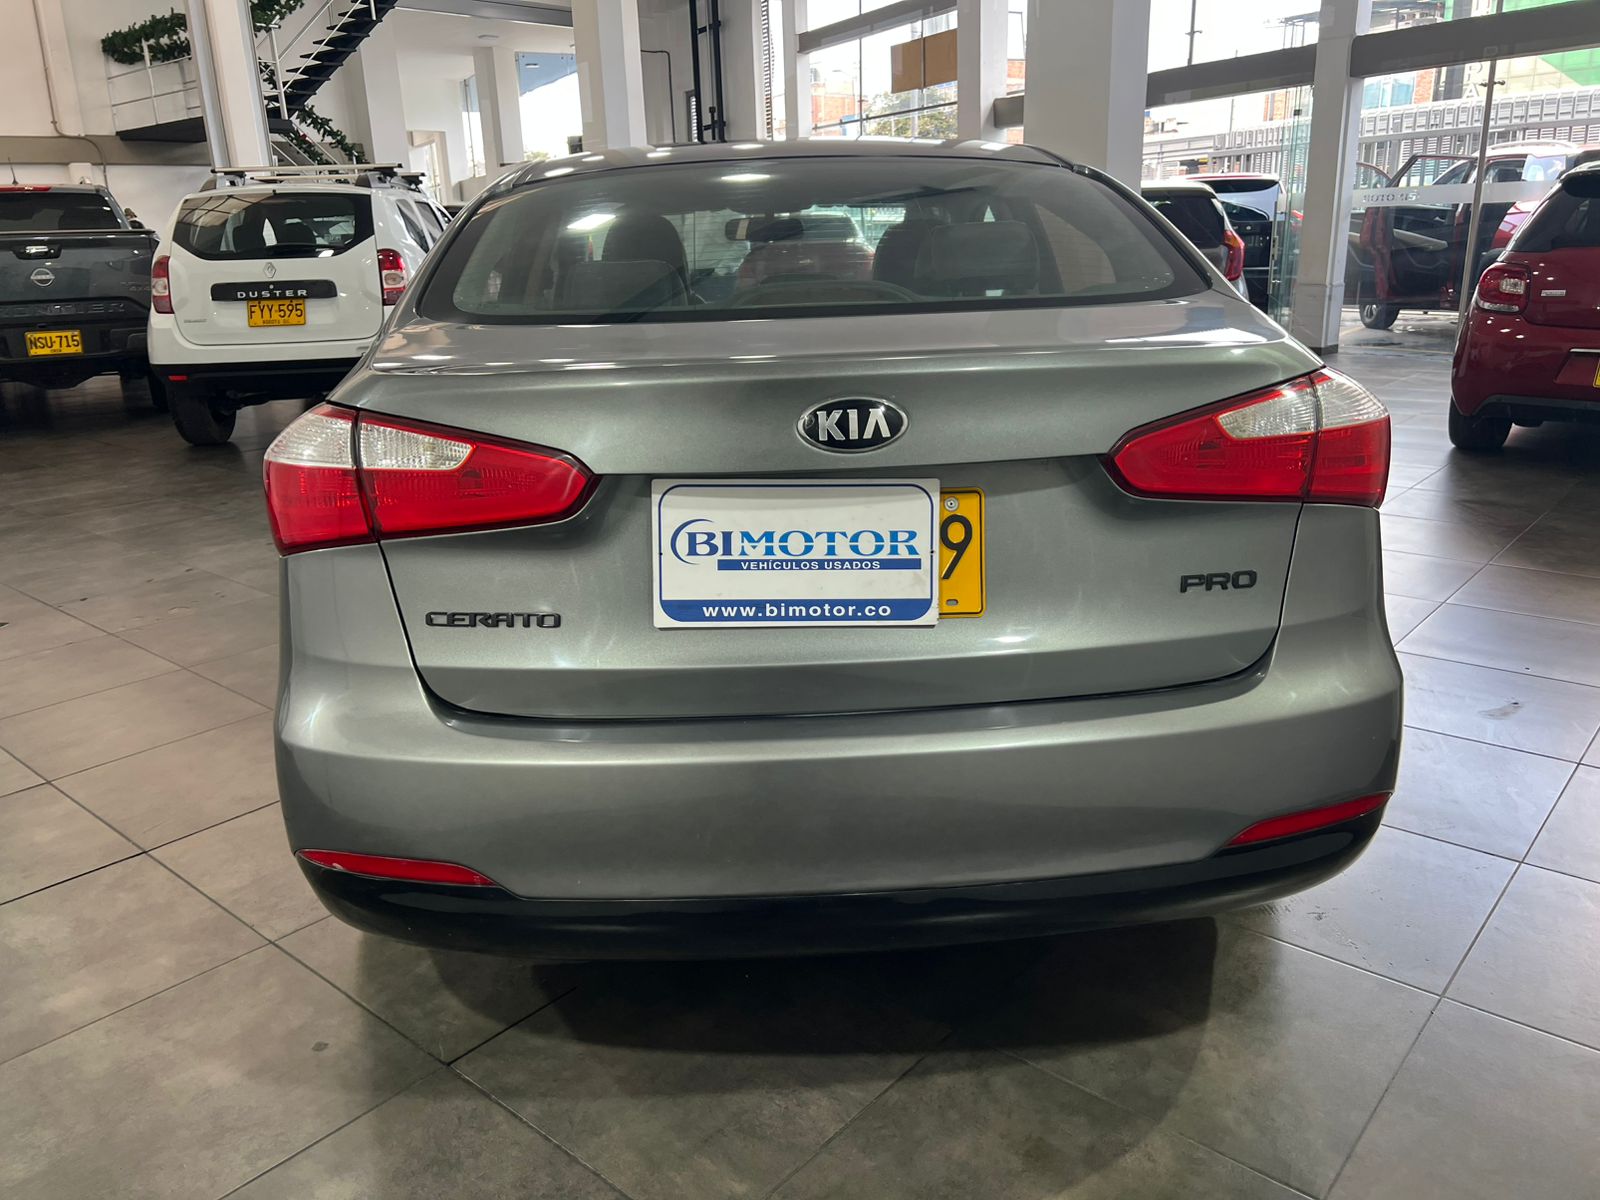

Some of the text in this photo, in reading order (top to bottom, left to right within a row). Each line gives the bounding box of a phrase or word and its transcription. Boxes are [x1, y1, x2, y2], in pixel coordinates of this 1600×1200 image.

[237, 290, 307, 299] DUSTER
[816, 408, 891, 441] KIA
[683, 528, 920, 558] BIMOTOR
[741, 560, 881, 570] VEHÍCULOS USADOS
[1180, 570, 1257, 593] PRO
[702, 603, 892, 618] www.bimotor.co
[425, 611, 561, 628] CERATO
